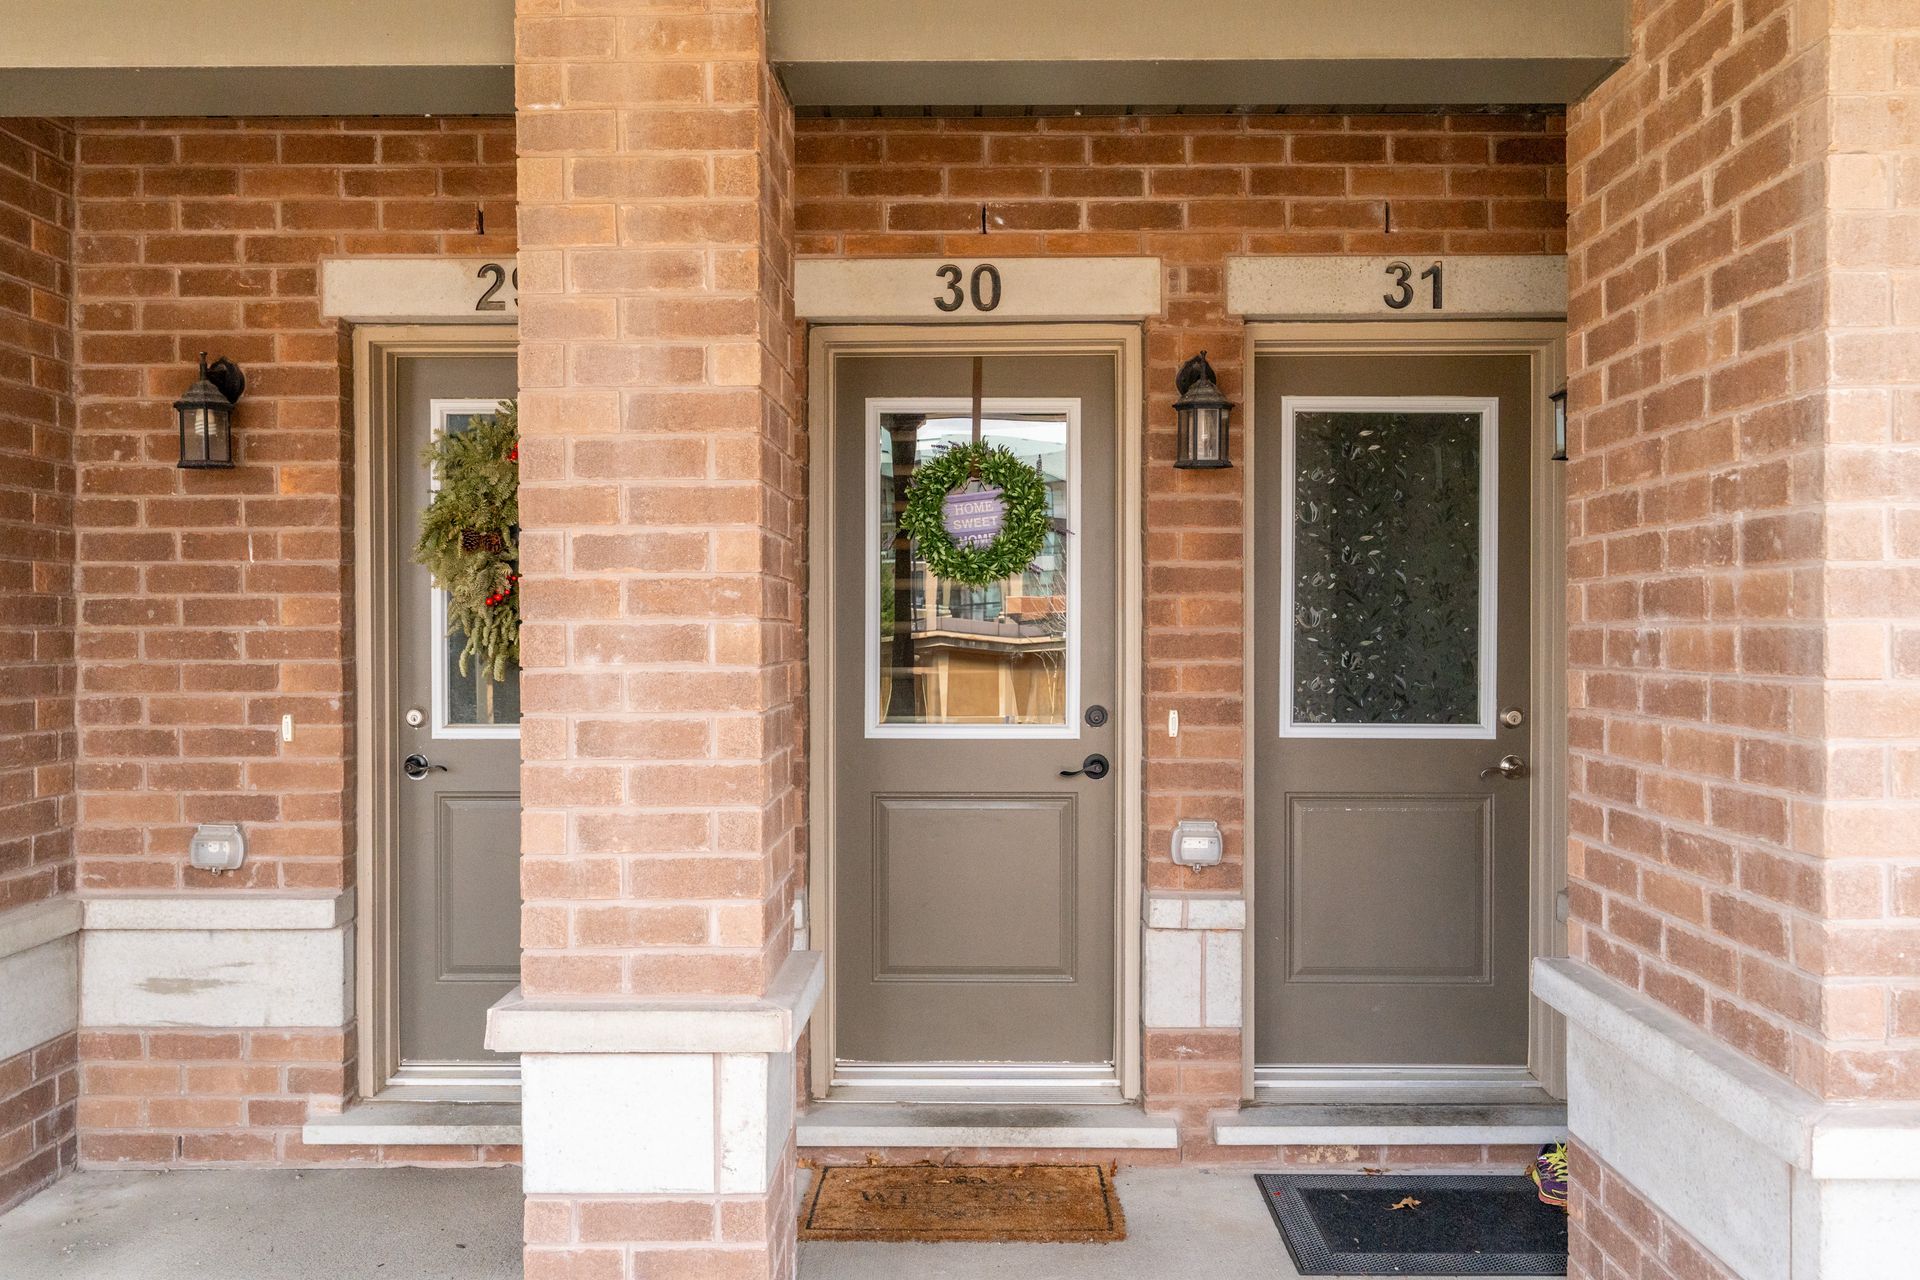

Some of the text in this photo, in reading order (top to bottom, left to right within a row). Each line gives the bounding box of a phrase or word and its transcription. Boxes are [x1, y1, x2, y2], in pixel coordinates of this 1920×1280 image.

[476, 263, 518, 311] 2
[933, 263, 1001, 312] 30
[1383, 260, 1442, 309] 31
[953, 501, 994, 515] HOME
[953, 516, 998, 530] SWEET
